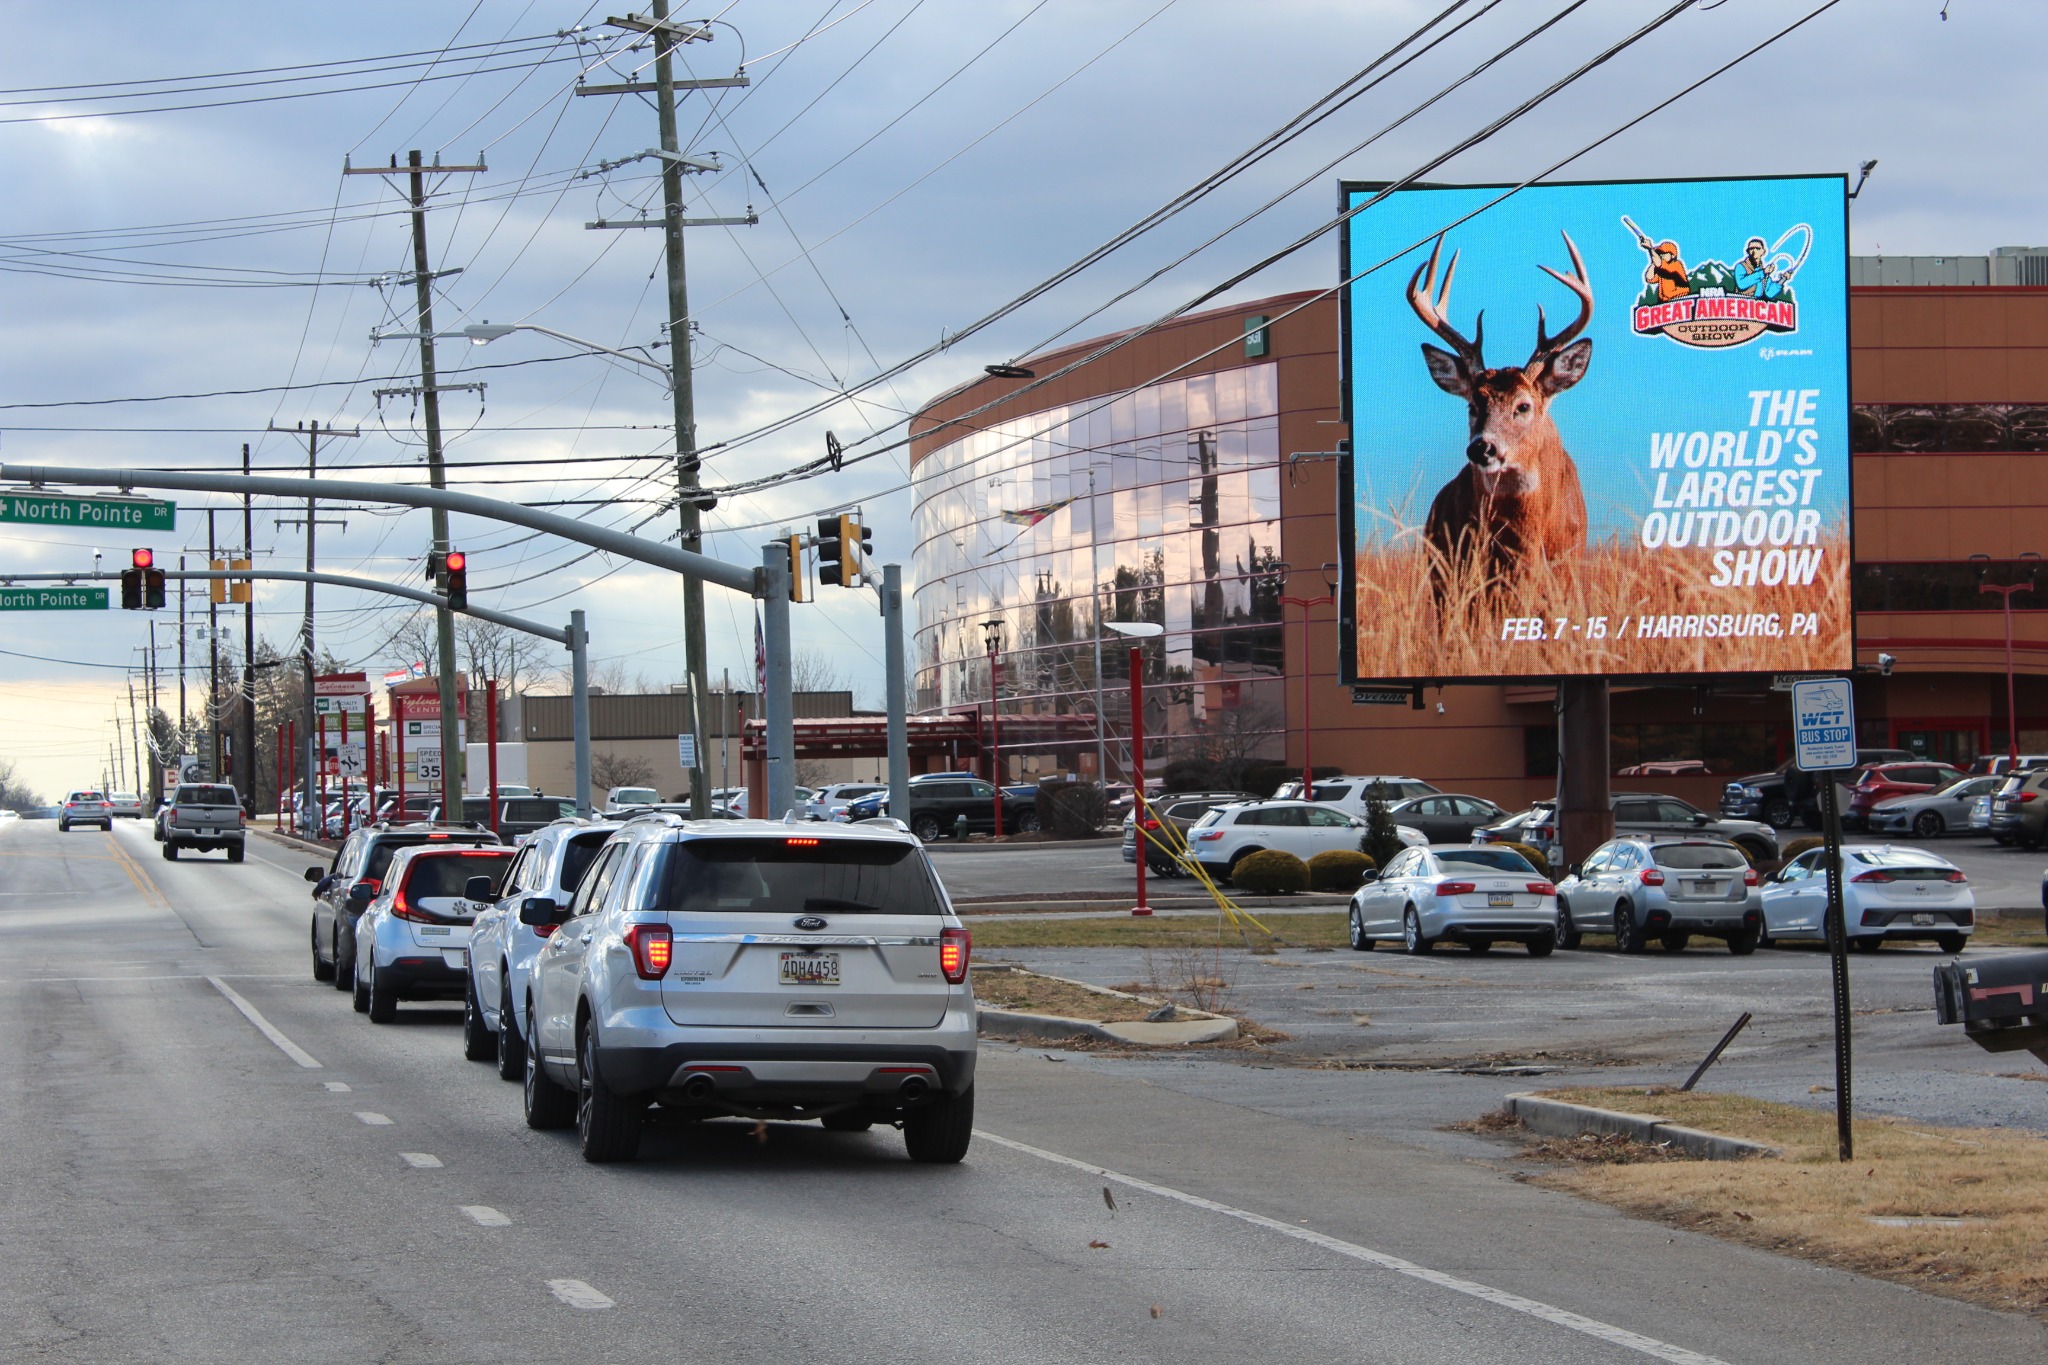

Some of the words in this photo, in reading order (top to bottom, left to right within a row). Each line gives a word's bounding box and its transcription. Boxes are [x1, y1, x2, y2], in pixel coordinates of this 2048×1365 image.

[1637, 299, 1694, 330] GREAT
[1695, 298, 1793, 327] AMERICAN
[1678, 323, 1750, 333] OUTDOOR
[1692, 332, 1735, 341] SHOW
[1748, 389, 1820, 427] THE
[1650, 428, 1819, 469] WORLD'S
[1653, 469, 1822, 509] LARGEST
[14, 499, 71, 520] North
[79, 502, 143, 524] Pointe
[154, 506, 168, 517] DR
[1642, 509, 1821, 549] OUTDOOR
[1710, 548, 1823, 588] SHOW
[0, 593, 35, 607] orth
[40, 592, 87, 606] Pointe
[95, 592, 105, 600] DR
[1501, 617, 1548, 641] FEB.
[1553, 617, 1569, 640] 7
[1585, 616, 1608, 639] 15
[1637, 613, 1785, 639] HARRISBURG,
[1789, 612, 1819, 637] PA
[319, 682, 355, 690] Sylvania
[1802, 711, 1845, 726] WCT
[1801, 730, 1821, 743] BUS
[1824, 729, 1848, 742] STOP
[420, 765, 441, 778] 35
[801, 918, 821, 927] Ford
[783, 961, 838, 977] 4DH4458
